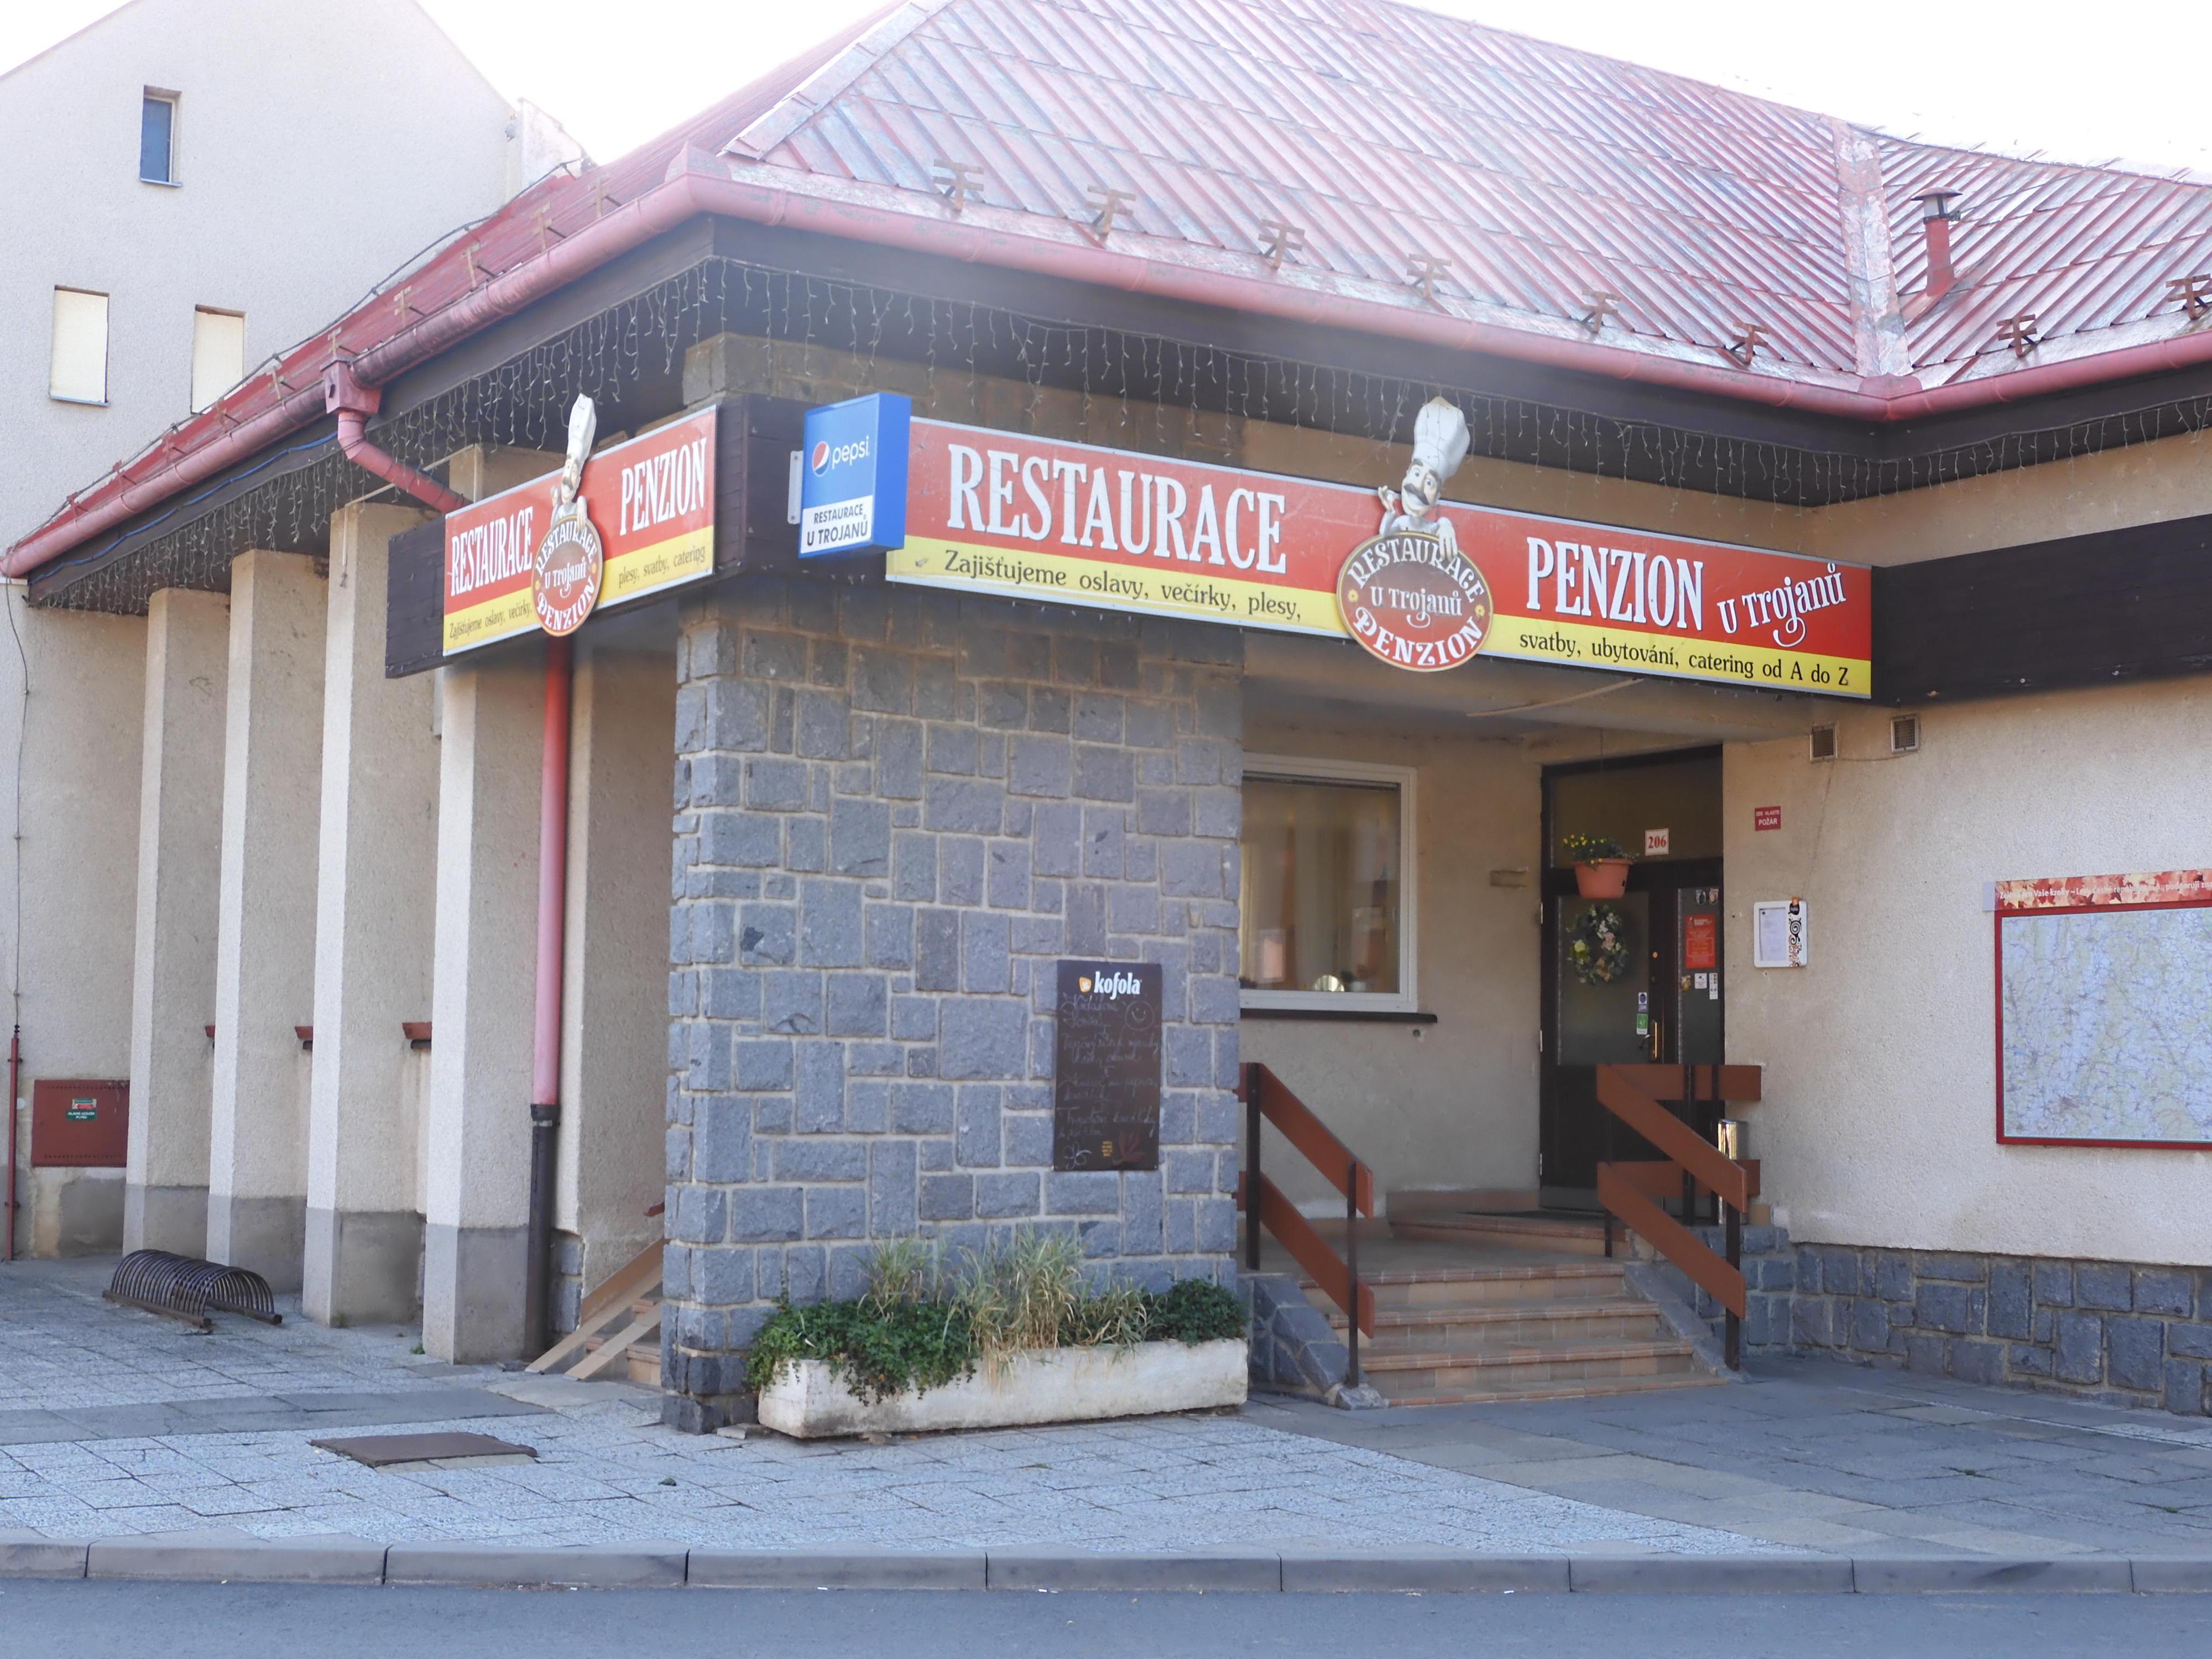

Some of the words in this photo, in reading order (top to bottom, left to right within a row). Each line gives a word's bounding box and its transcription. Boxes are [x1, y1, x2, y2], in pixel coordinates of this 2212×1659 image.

[832, 435, 869, 469] pepsi
[620, 438, 706, 535] PENZION
[947, 443, 1286, 574] RESTAURACE
[807, 531, 815, 546] U
[818, 514, 868, 544] TROJANŮ
[814, 504, 863, 524] RESTAURACE
[451, 507, 534, 596] RESTAURACE
[619, 565, 639, 588] plesy,
[643, 555, 669, 576] svatby,
[673, 545, 705, 567] catering
[537, 576, 594, 630] PENZION
[945, 549, 1066, 586] Zajišťujeme
[1079, 569, 1149, 599] oslavy,
[1161, 582, 1237, 612] večírky,
[1248, 592, 1301, 621] plesy,
[1370, 586, 1384, 607] U
[1389, 588, 1463, 628] Trojanů
[1526, 536, 1703, 631] PENZION
[1717, 598, 1738, 634] U
[1741, 562, 1846, 648] Trojanů
[485, 609, 505, 627] oslavy,
[1353, 607, 1483, 666] PENZION
[1520, 632, 1581, 656] svatby,
[1592, 637, 1679, 668] ubytování,
[1689, 653, 1754, 679] catering
[1762, 659, 1782, 679] od
[1791, 661, 1803, 681] A
[1811, 665, 1830, 684] do
[1838, 666, 1849, 686] Z
[1648, 835, 1666, 848] 206
[1094, 971, 1141, 1000] kofola
